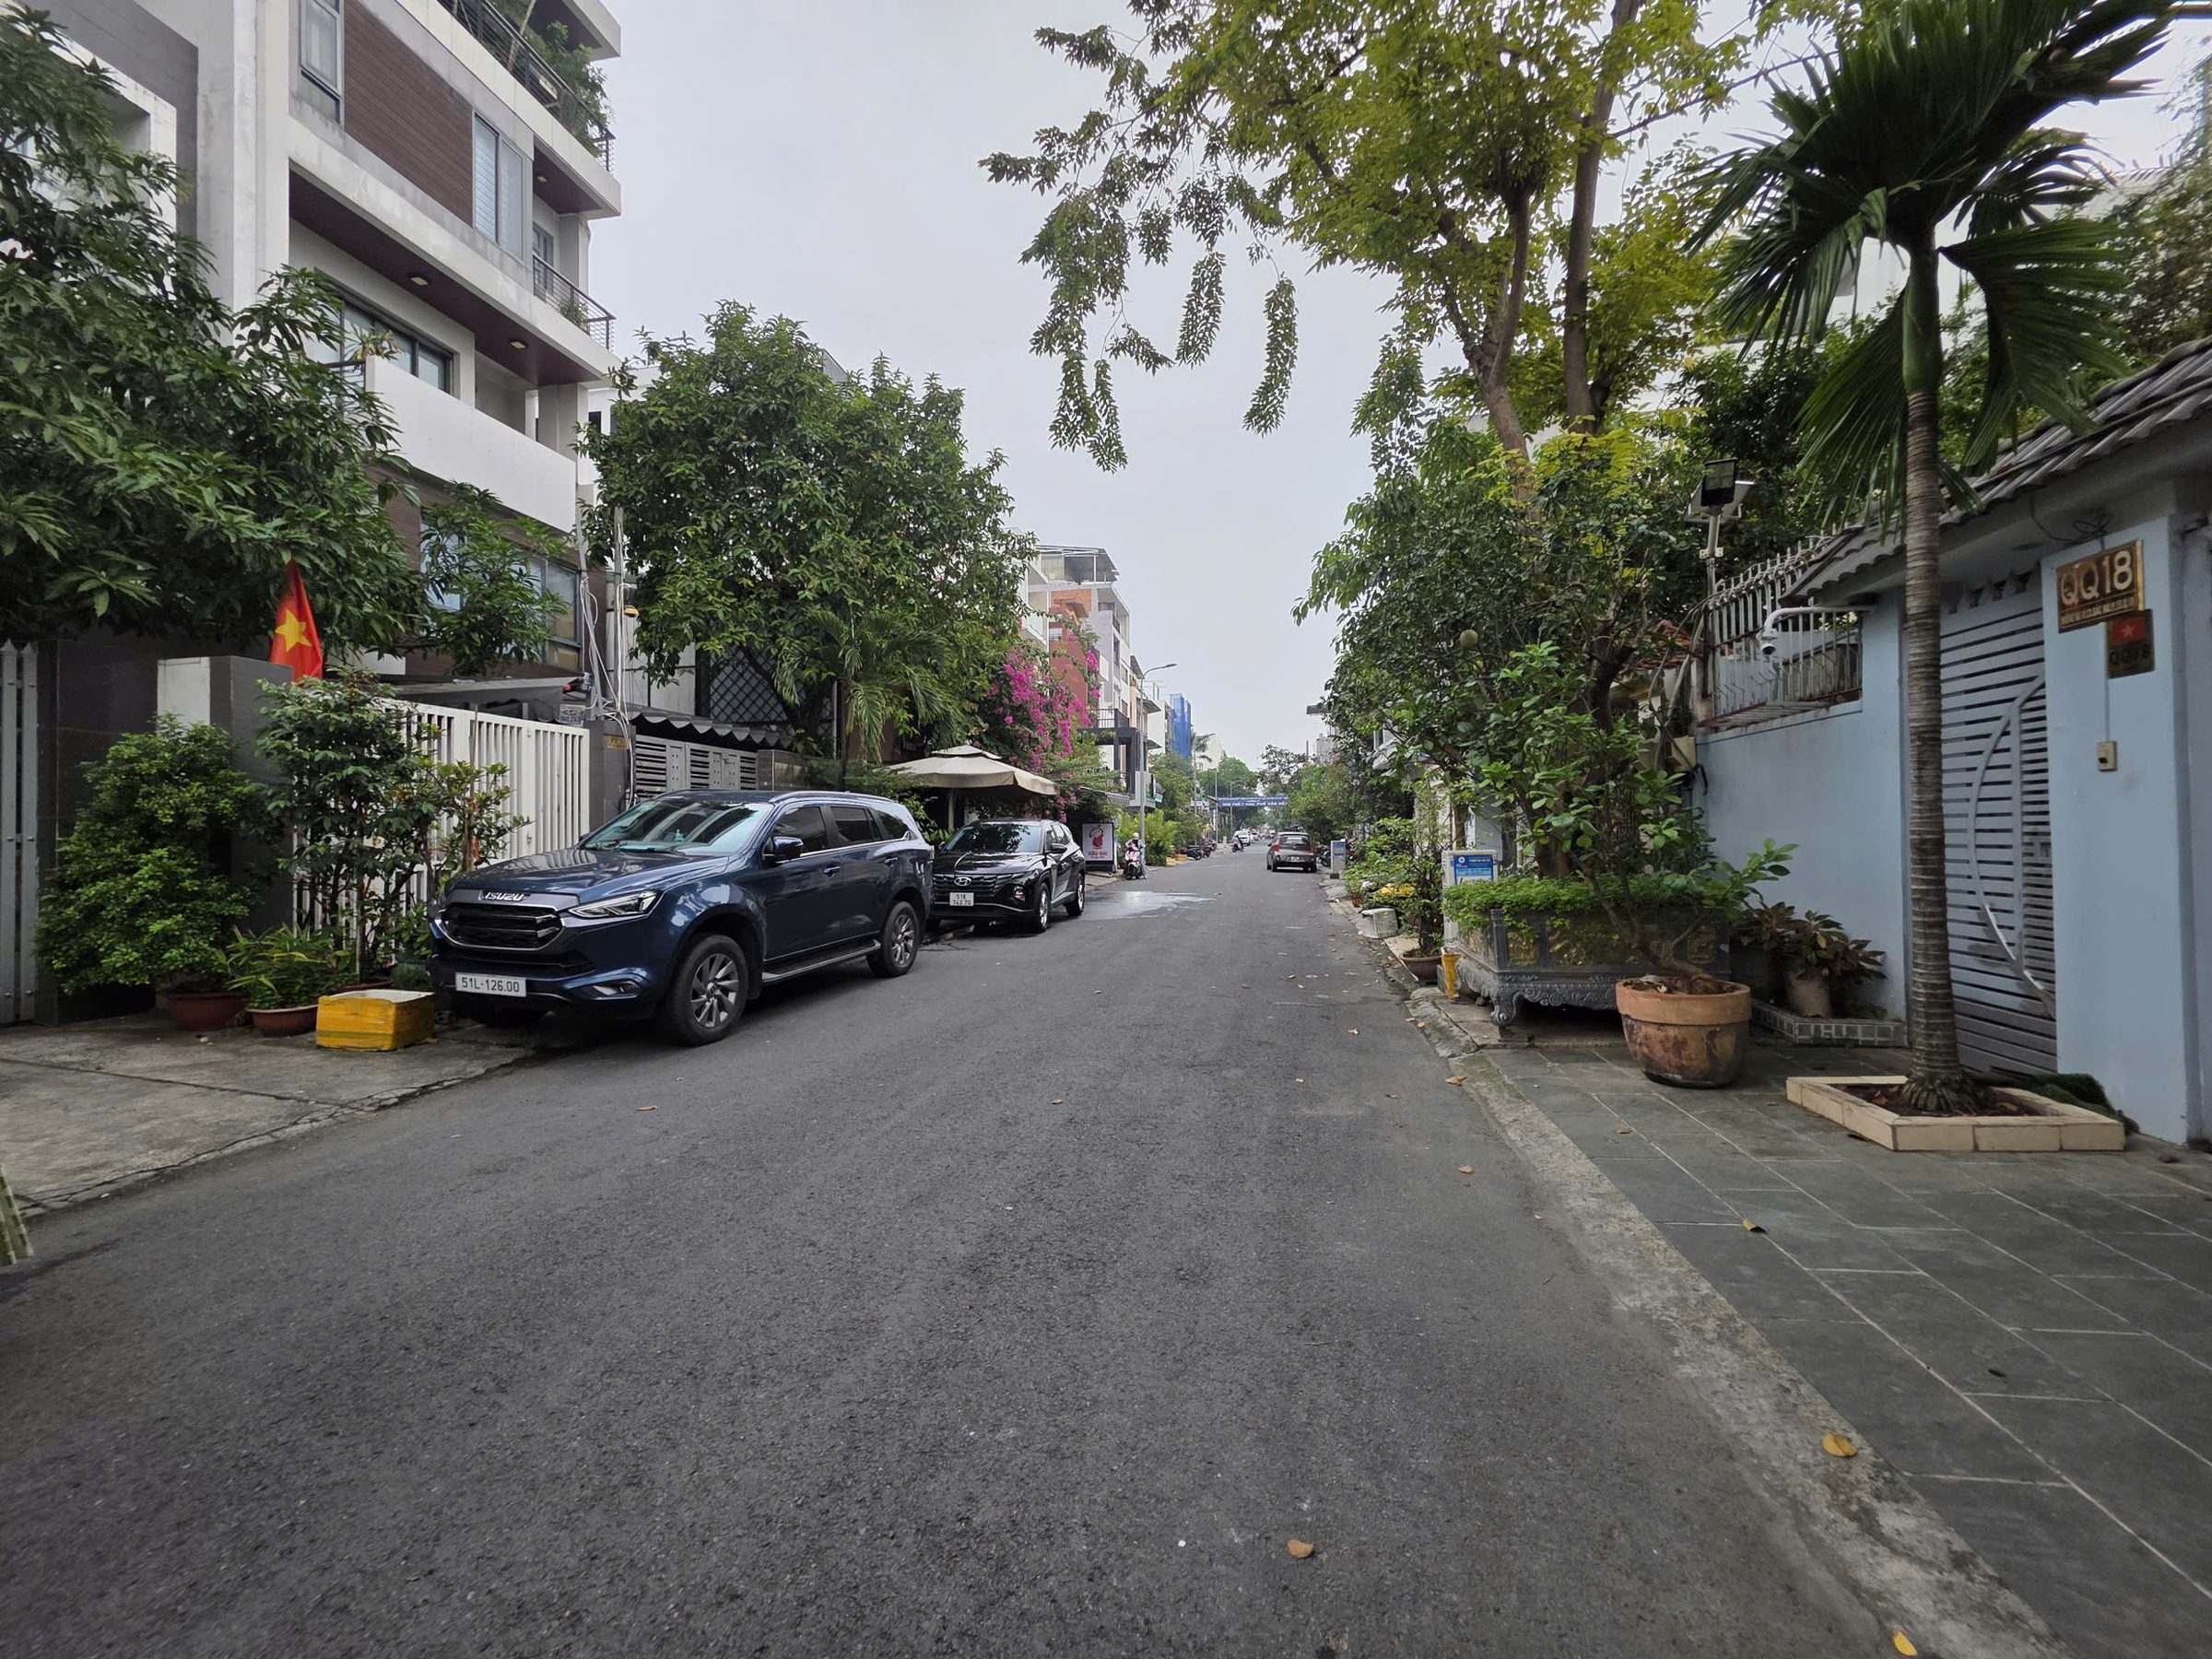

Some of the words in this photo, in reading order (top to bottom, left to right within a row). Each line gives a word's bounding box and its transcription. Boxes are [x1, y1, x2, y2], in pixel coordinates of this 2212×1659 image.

[2061, 549, 2133, 606] QQ18
[485, 891, 524, 901] ISUZU
[462, 977, 520, 993] 51L-126.00
